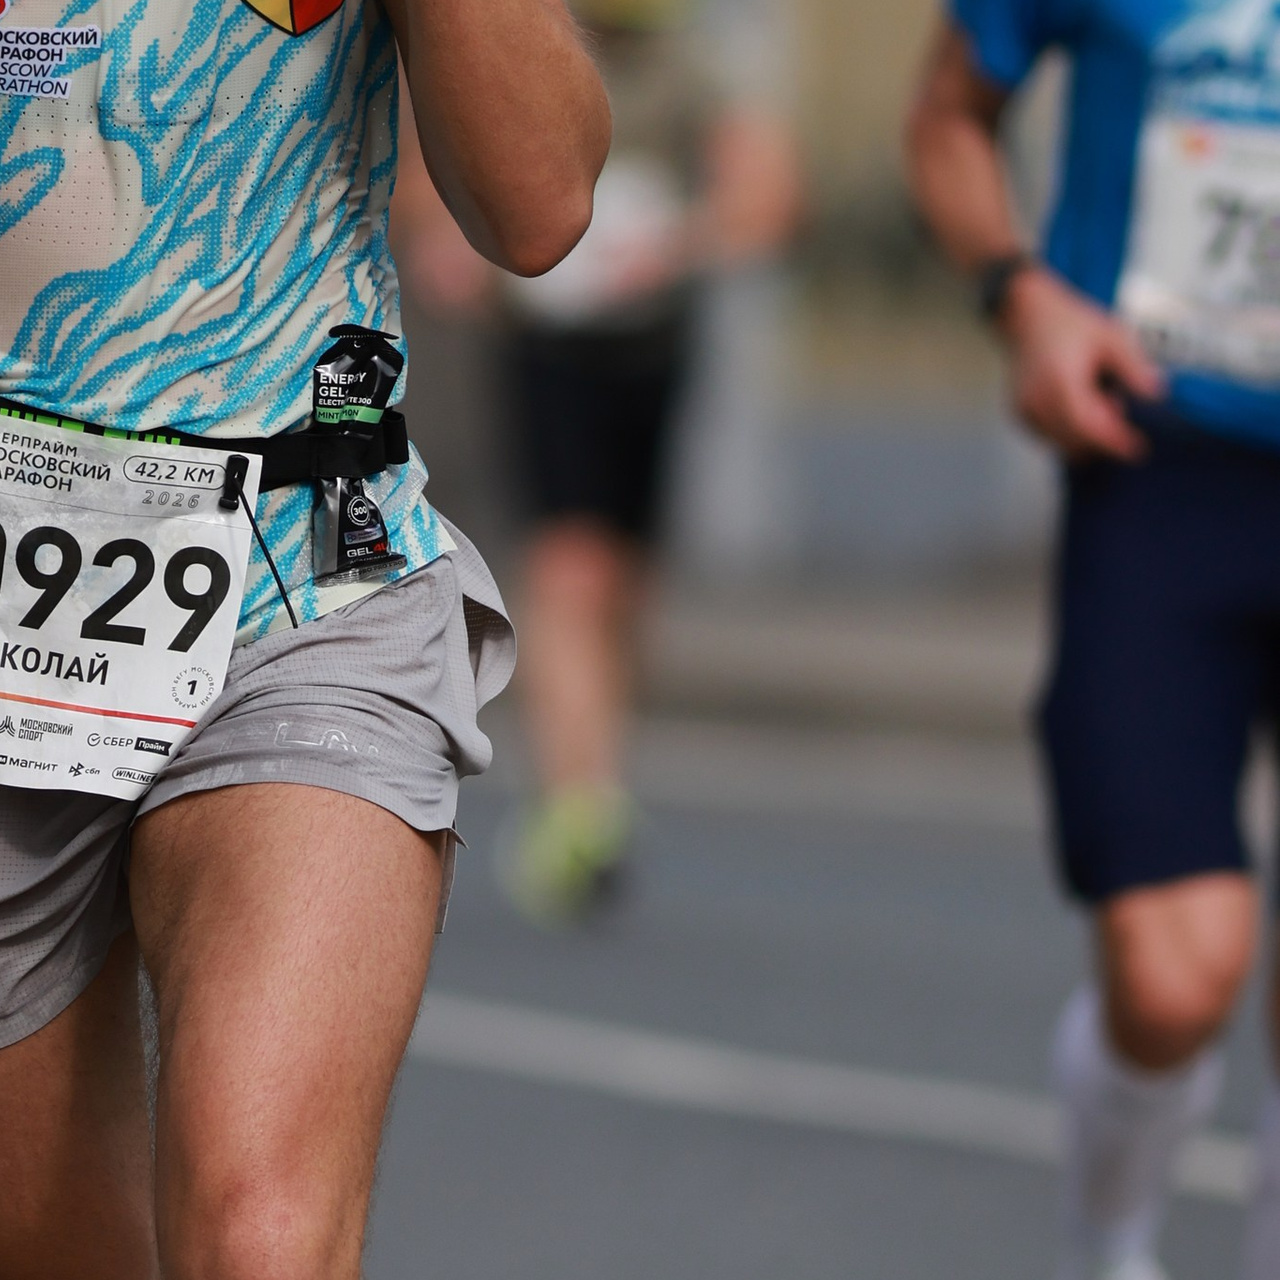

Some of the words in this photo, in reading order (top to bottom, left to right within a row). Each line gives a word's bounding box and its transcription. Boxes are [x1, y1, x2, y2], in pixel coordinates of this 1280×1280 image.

[317, 411, 340, 420] MINT
[134, 461, 177, 481] 42,2
[142, 490, 201, 509] 2026
[353, 506, 367, 516] 300
[187, 680, 197, 695] 1
[20, 718, 73, 736] МОСКОВСКИЙ
[18, 728, 44, 742] СПОРТ
[103, 736, 133, 747] СБЕР
[138, 740, 165, 751] Прайм
[9, 757, 58, 771] магнит
[85, 767, 101, 775] сбп
[115, 770, 152, 783] WINLINE
